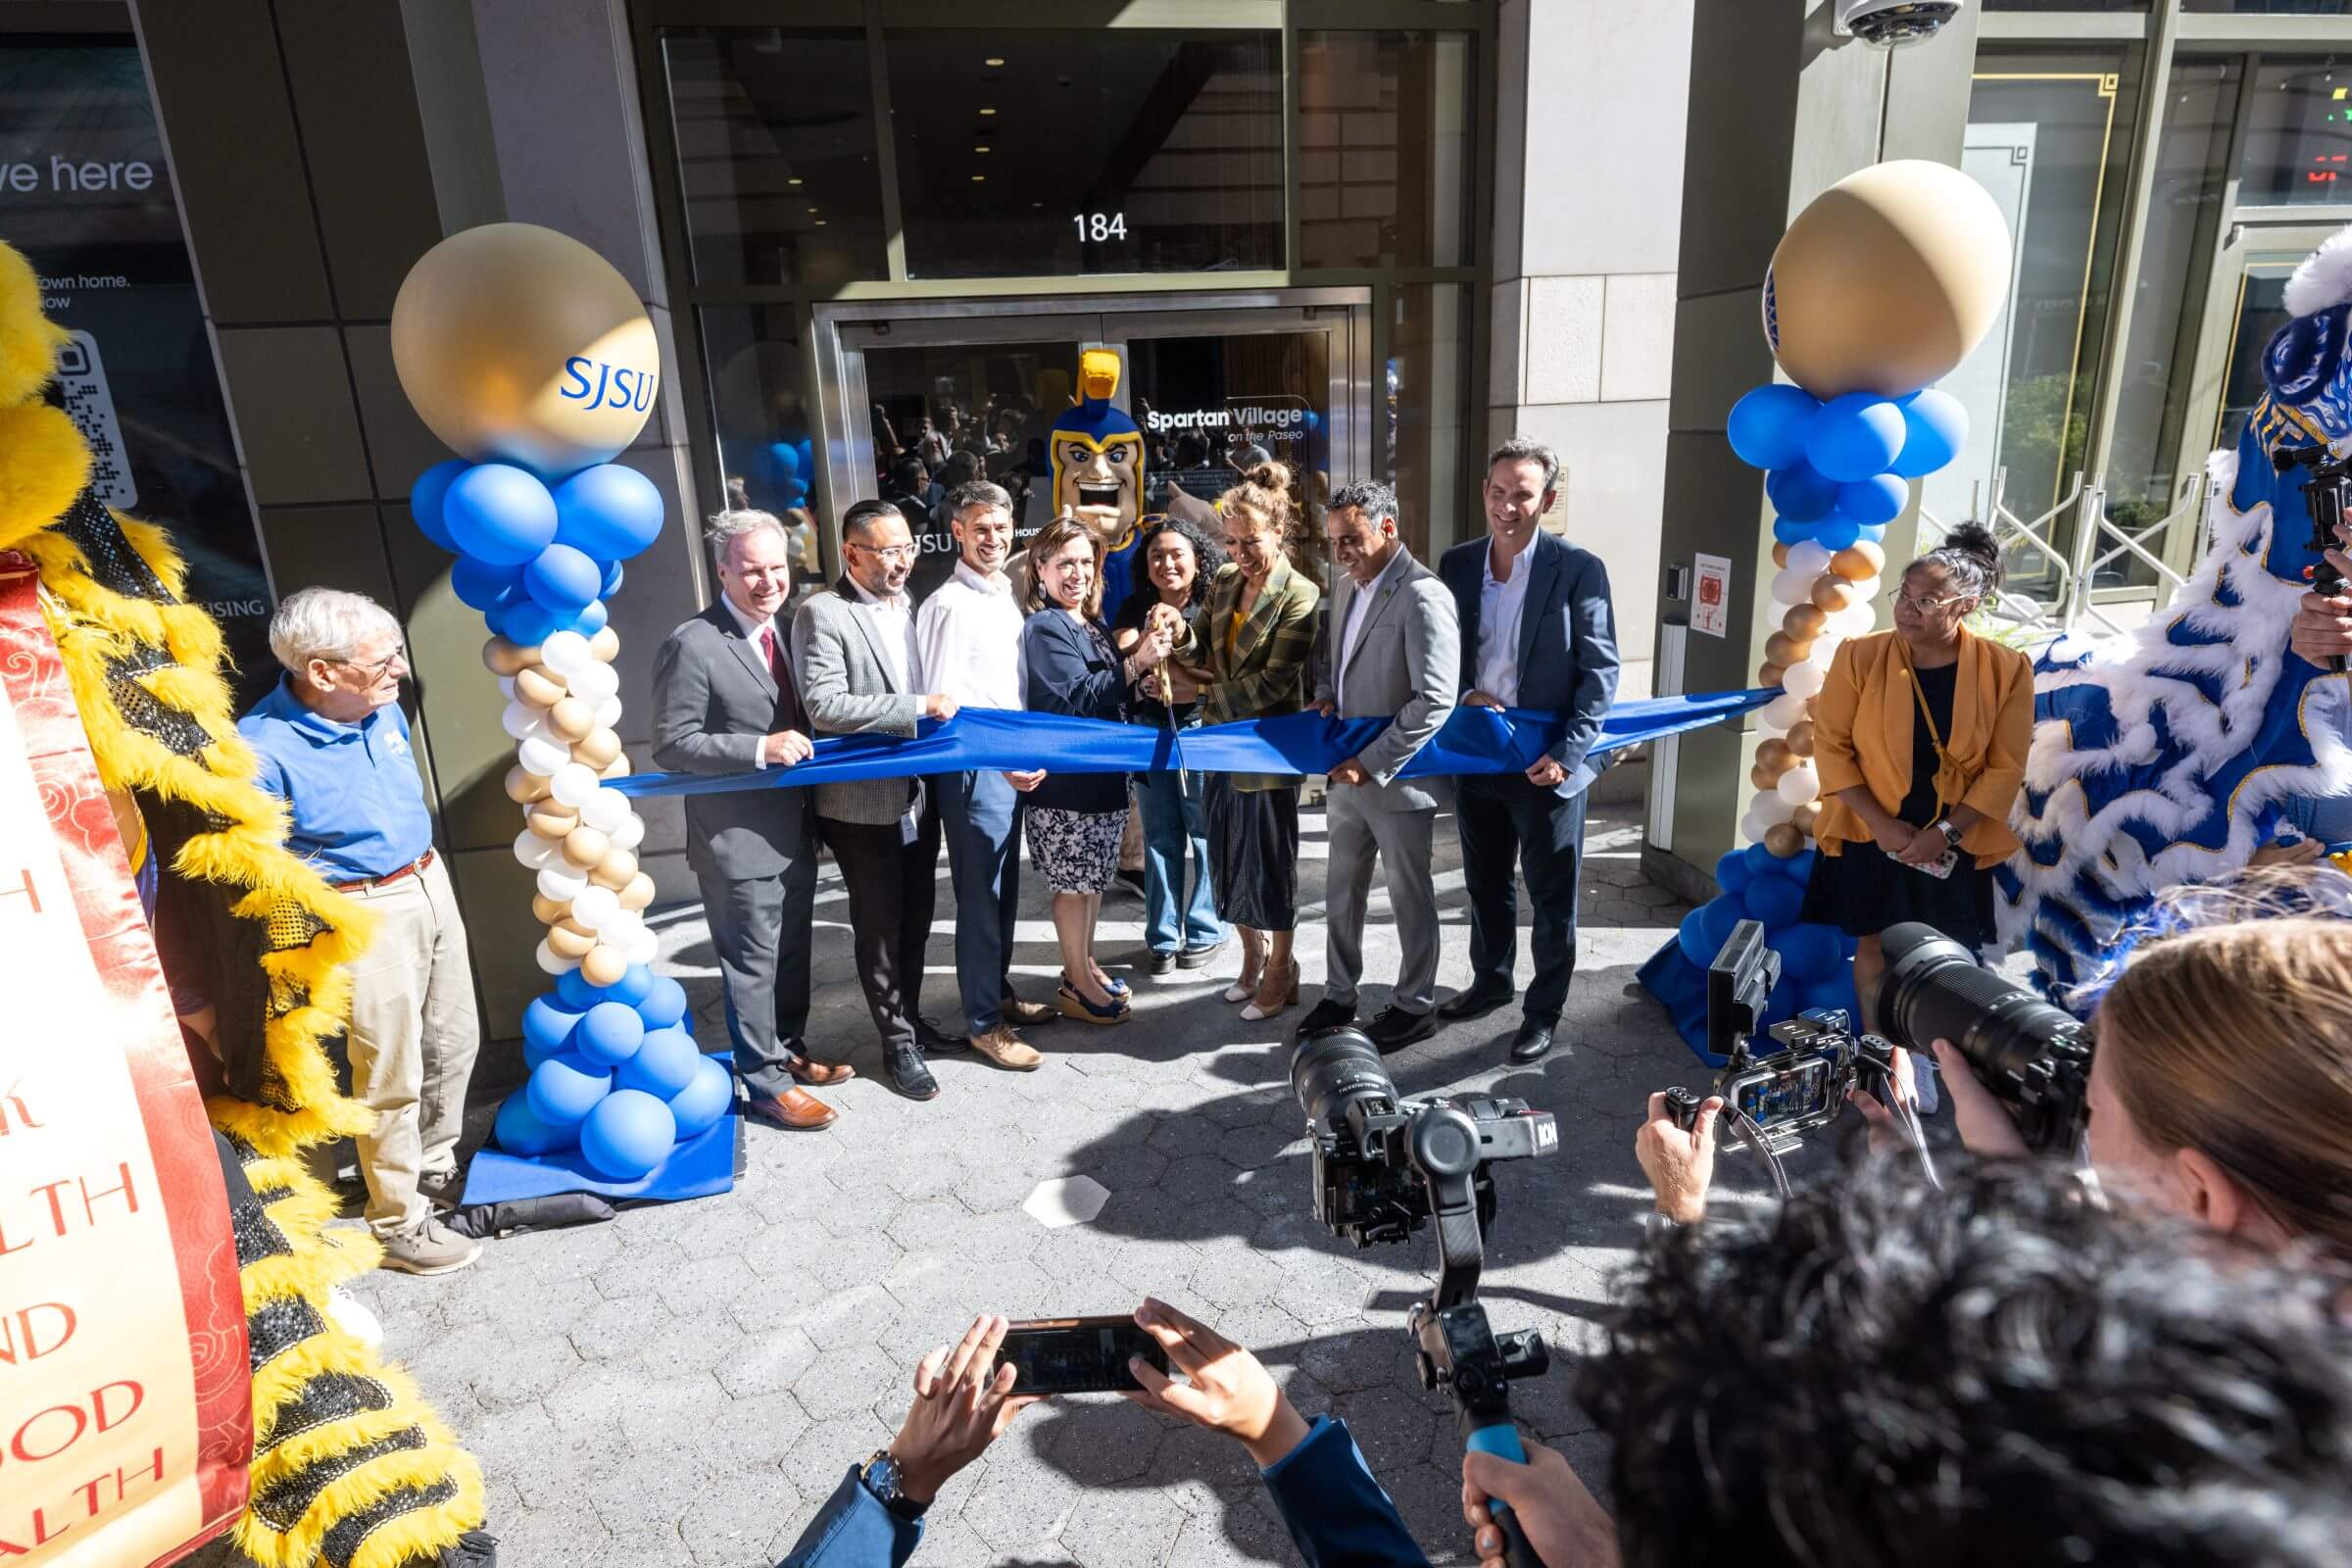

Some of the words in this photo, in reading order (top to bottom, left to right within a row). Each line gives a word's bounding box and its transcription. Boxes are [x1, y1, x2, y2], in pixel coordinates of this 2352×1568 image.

[51, 156, 154, 191] here
[1074, 212, 1127, 242] 184
[78, 273, 131, 288] home.
[561, 356, 655, 413] SJSU
[1148, 409, 1230, 431] Spartan
[1233, 406, 1302, 427] Village
[1228, 432, 1244, 443] on
[1247, 430, 1264, 442] the
[1268, 430, 1303, 440] Paseo
[913, 533, 953, 557] JSU
[0, 1380, 144, 1467] OD
